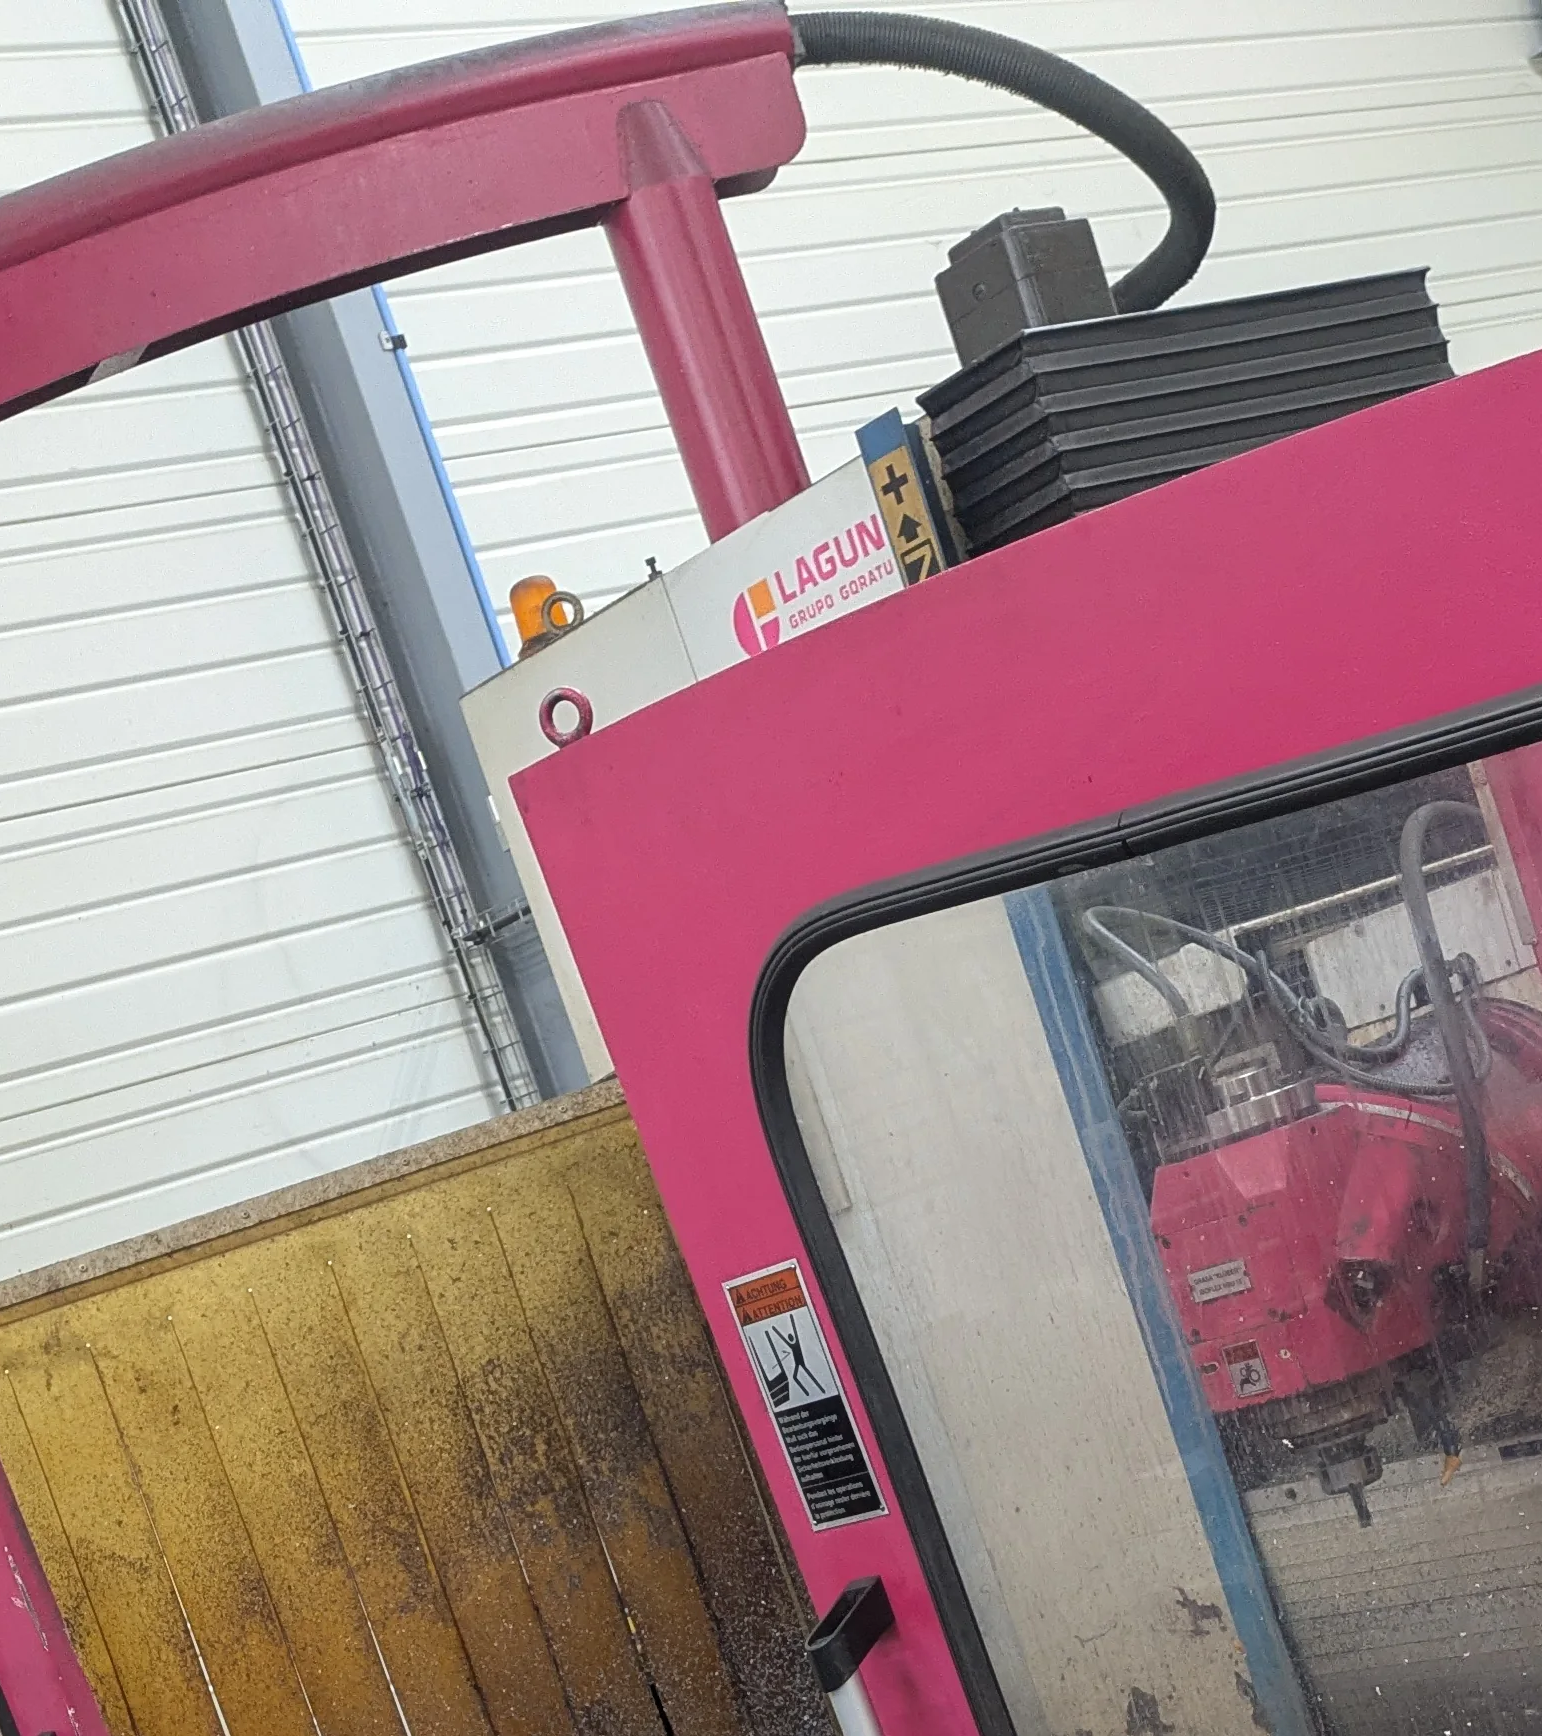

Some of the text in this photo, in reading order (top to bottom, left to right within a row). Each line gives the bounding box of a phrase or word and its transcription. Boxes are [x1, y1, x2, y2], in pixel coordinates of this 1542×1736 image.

[774, 513, 885, 604] LAGUN
[788, 559, 894, 629] GRUPO GORATU
[746, 1281, 788, 1300] ACHTUNG
[752, 1295, 803, 1319] ATTENTION
